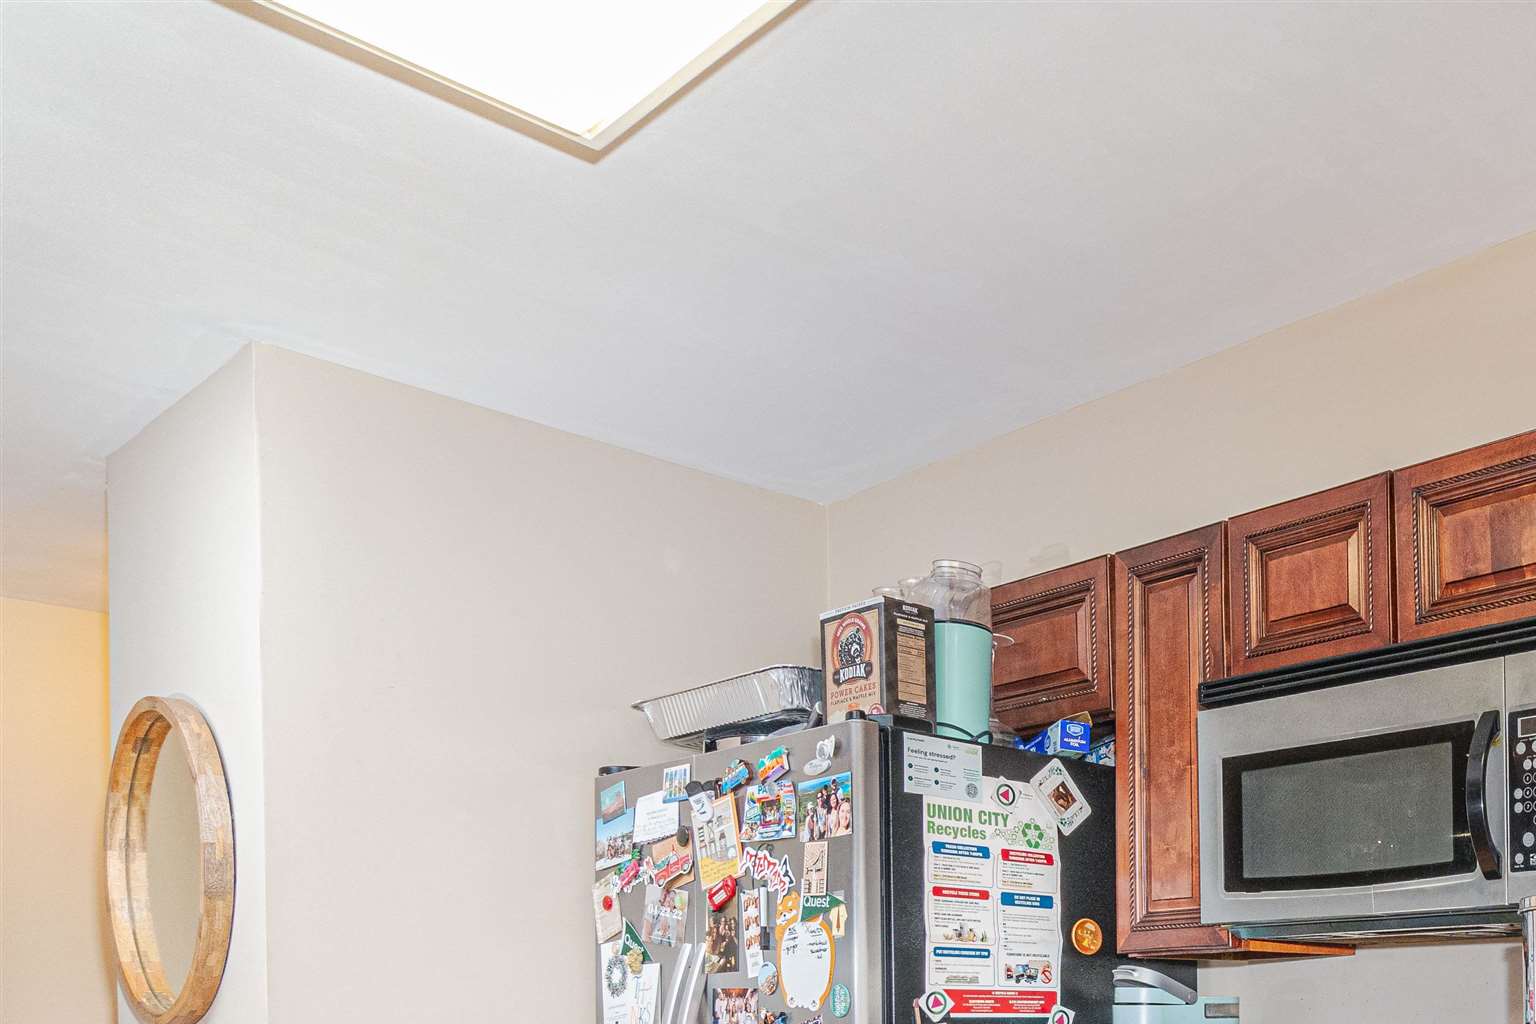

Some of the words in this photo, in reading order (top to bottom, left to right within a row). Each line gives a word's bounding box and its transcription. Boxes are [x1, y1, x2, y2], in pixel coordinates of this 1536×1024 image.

[840, 662, 866, 683] KODIAK
[830, 687, 853, 700] POWER
[854, 681, 876, 694] CAKES
[907, 746, 928, 757] Feeling
[928, 750, 957, 761] stressed?
[927, 802, 973, 825] UNION
[978, 809, 1009, 828] CITY
[927, 820, 987, 840] Recycles
[803, 895, 830, 908] Quest
